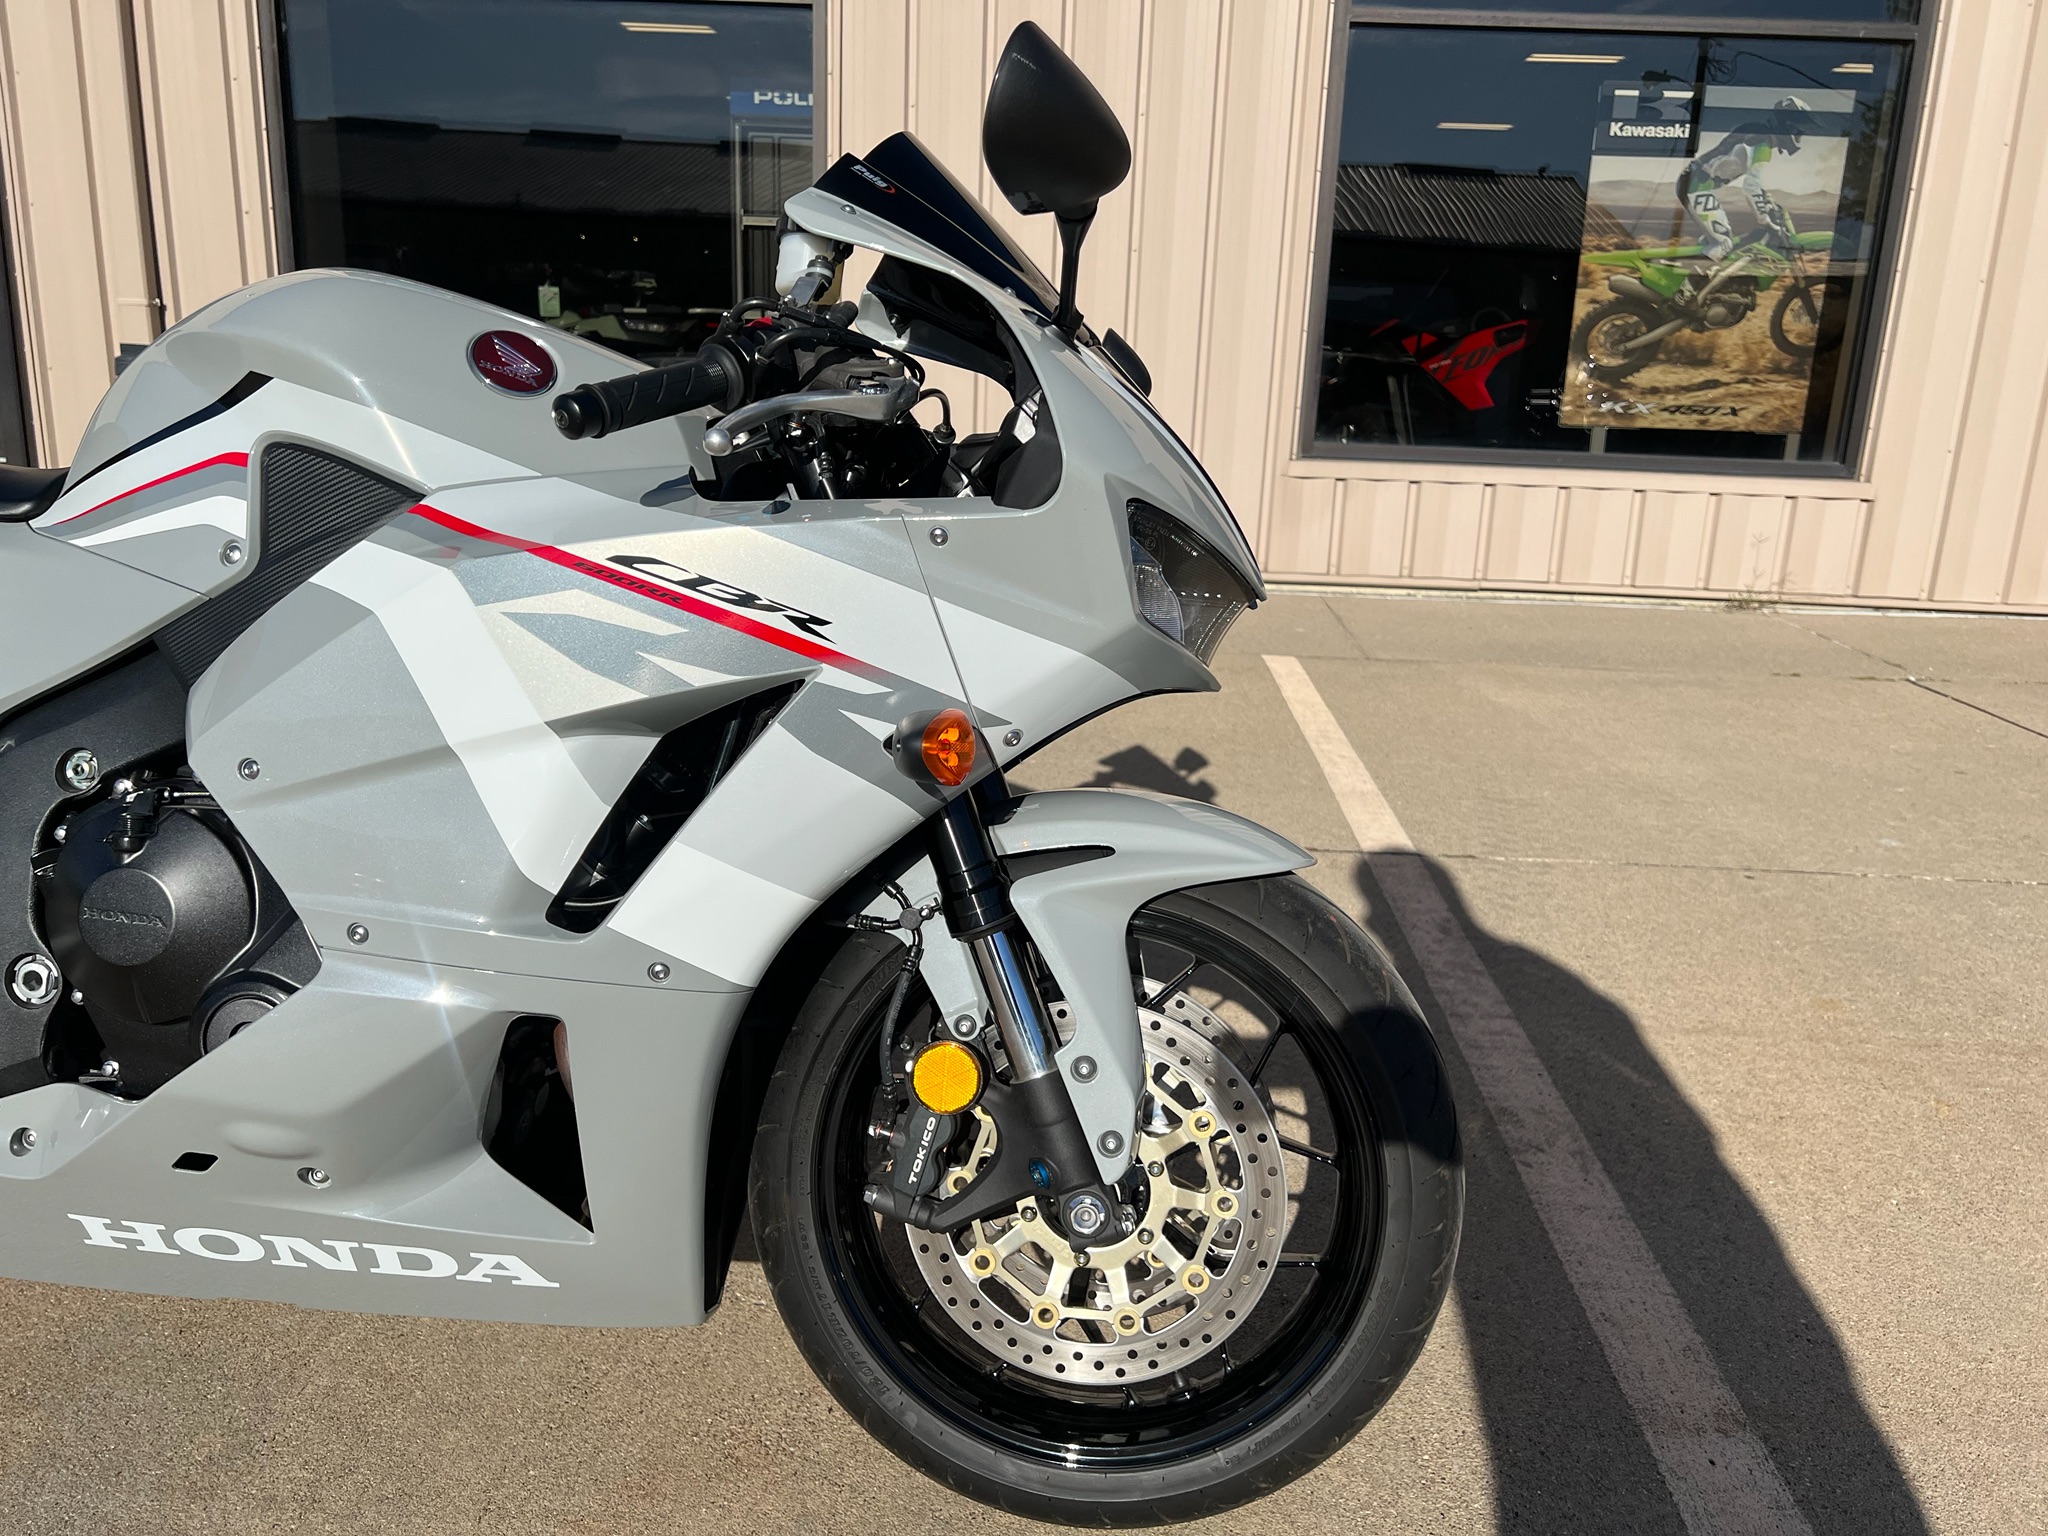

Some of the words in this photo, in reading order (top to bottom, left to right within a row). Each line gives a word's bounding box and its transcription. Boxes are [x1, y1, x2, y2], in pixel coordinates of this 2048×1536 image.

[753, 91, 813, 106] POL
[1609, 122, 1690, 138] Kawasaki
[853, 164, 888, 187] Puig
[478, 360, 538, 388] HONDA
[1599, 401, 1658, 415] KX
[573, 561, 683, 605] 600RR
[605, 554, 837, 645] CBR
[82, 907, 166, 932] HONDA
[908, 1116, 936, 1184] TOKICO
[66, 1213, 560, 1288] HONDA
[1311, 1276, 1392, 1411] SPORTMAX
